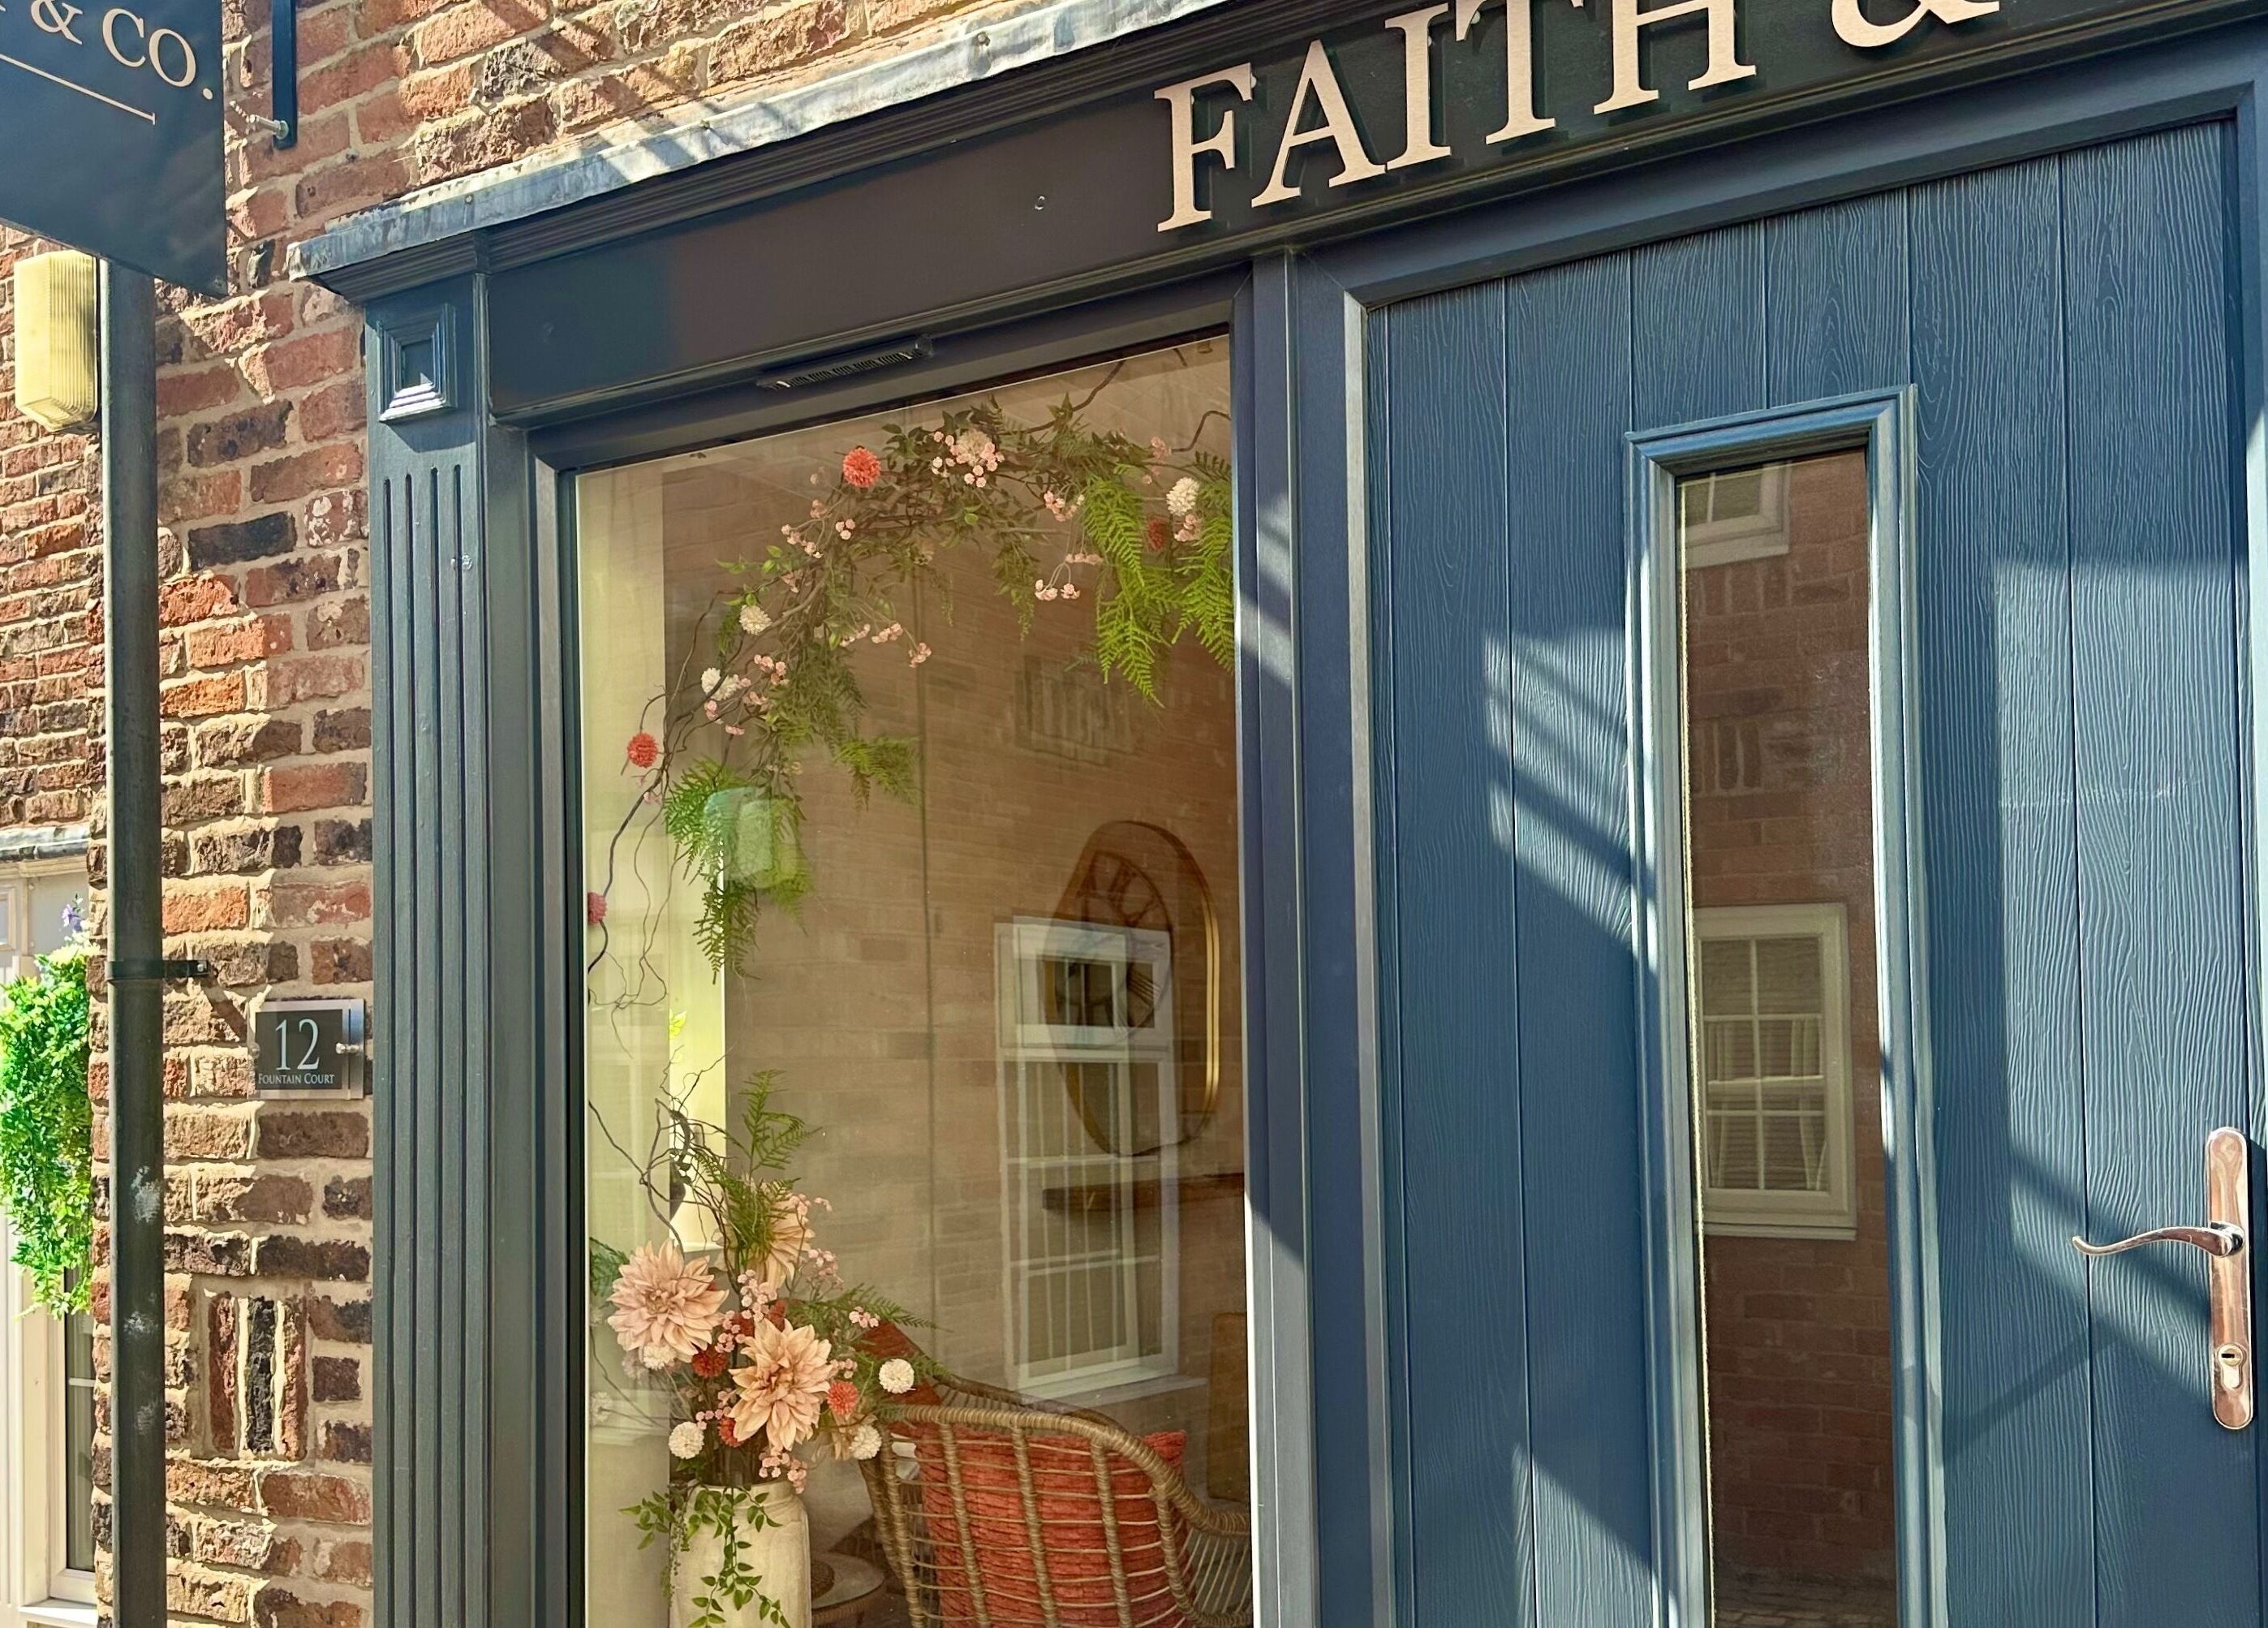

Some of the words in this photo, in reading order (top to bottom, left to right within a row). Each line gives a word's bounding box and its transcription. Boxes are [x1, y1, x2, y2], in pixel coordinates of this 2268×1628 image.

[31, 0, 83, 45] &
[102, 8, 213, 100] CO.
[1154, 0, 1757, 232] FAITH
[275, 1019, 320, 1070] 12
